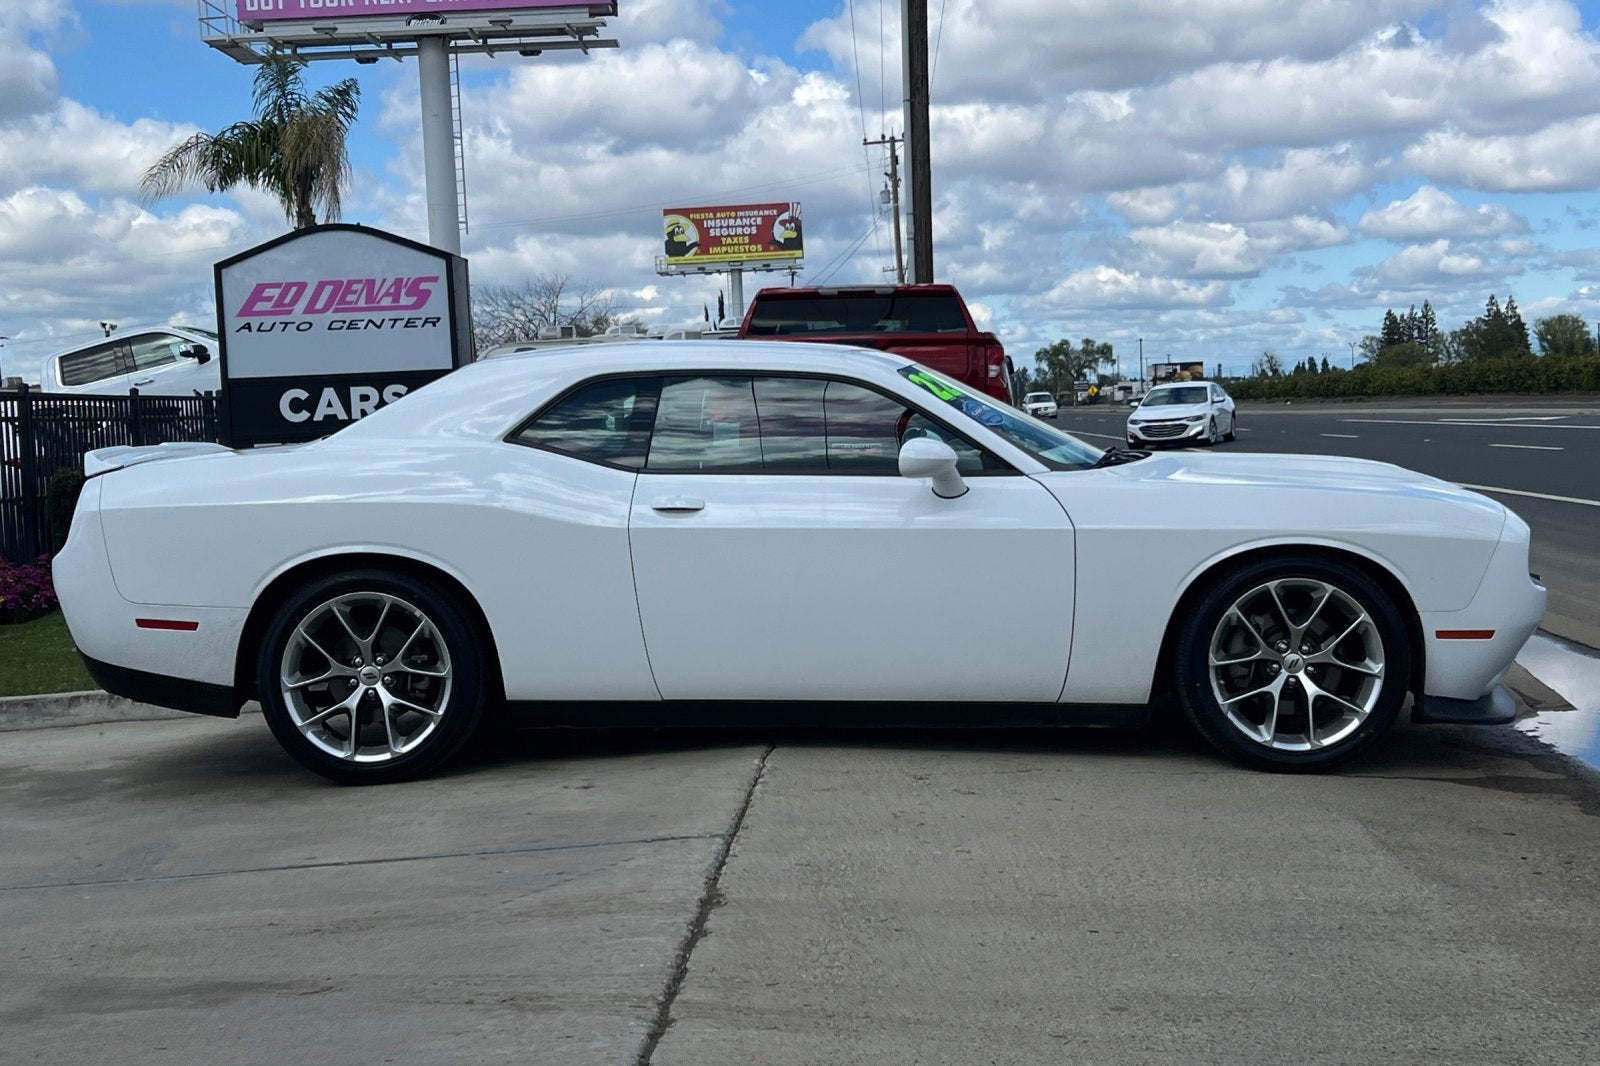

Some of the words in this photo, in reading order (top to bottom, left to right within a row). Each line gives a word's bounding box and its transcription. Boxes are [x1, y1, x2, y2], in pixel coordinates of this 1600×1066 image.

[737, 209, 777, 217] INSURANCE
[703, 217, 762, 228] INSURANCE
[709, 226, 757, 236] SEGUROS
[721, 236, 749, 245] TAXES
[709, 244, 762, 254] IMPUESTOS
[235, 281, 308, 317] ED
[302, 276, 439, 315] DENA'S
[235, 322, 313, 333] AUTO
[327, 317, 441, 330] CENTER
